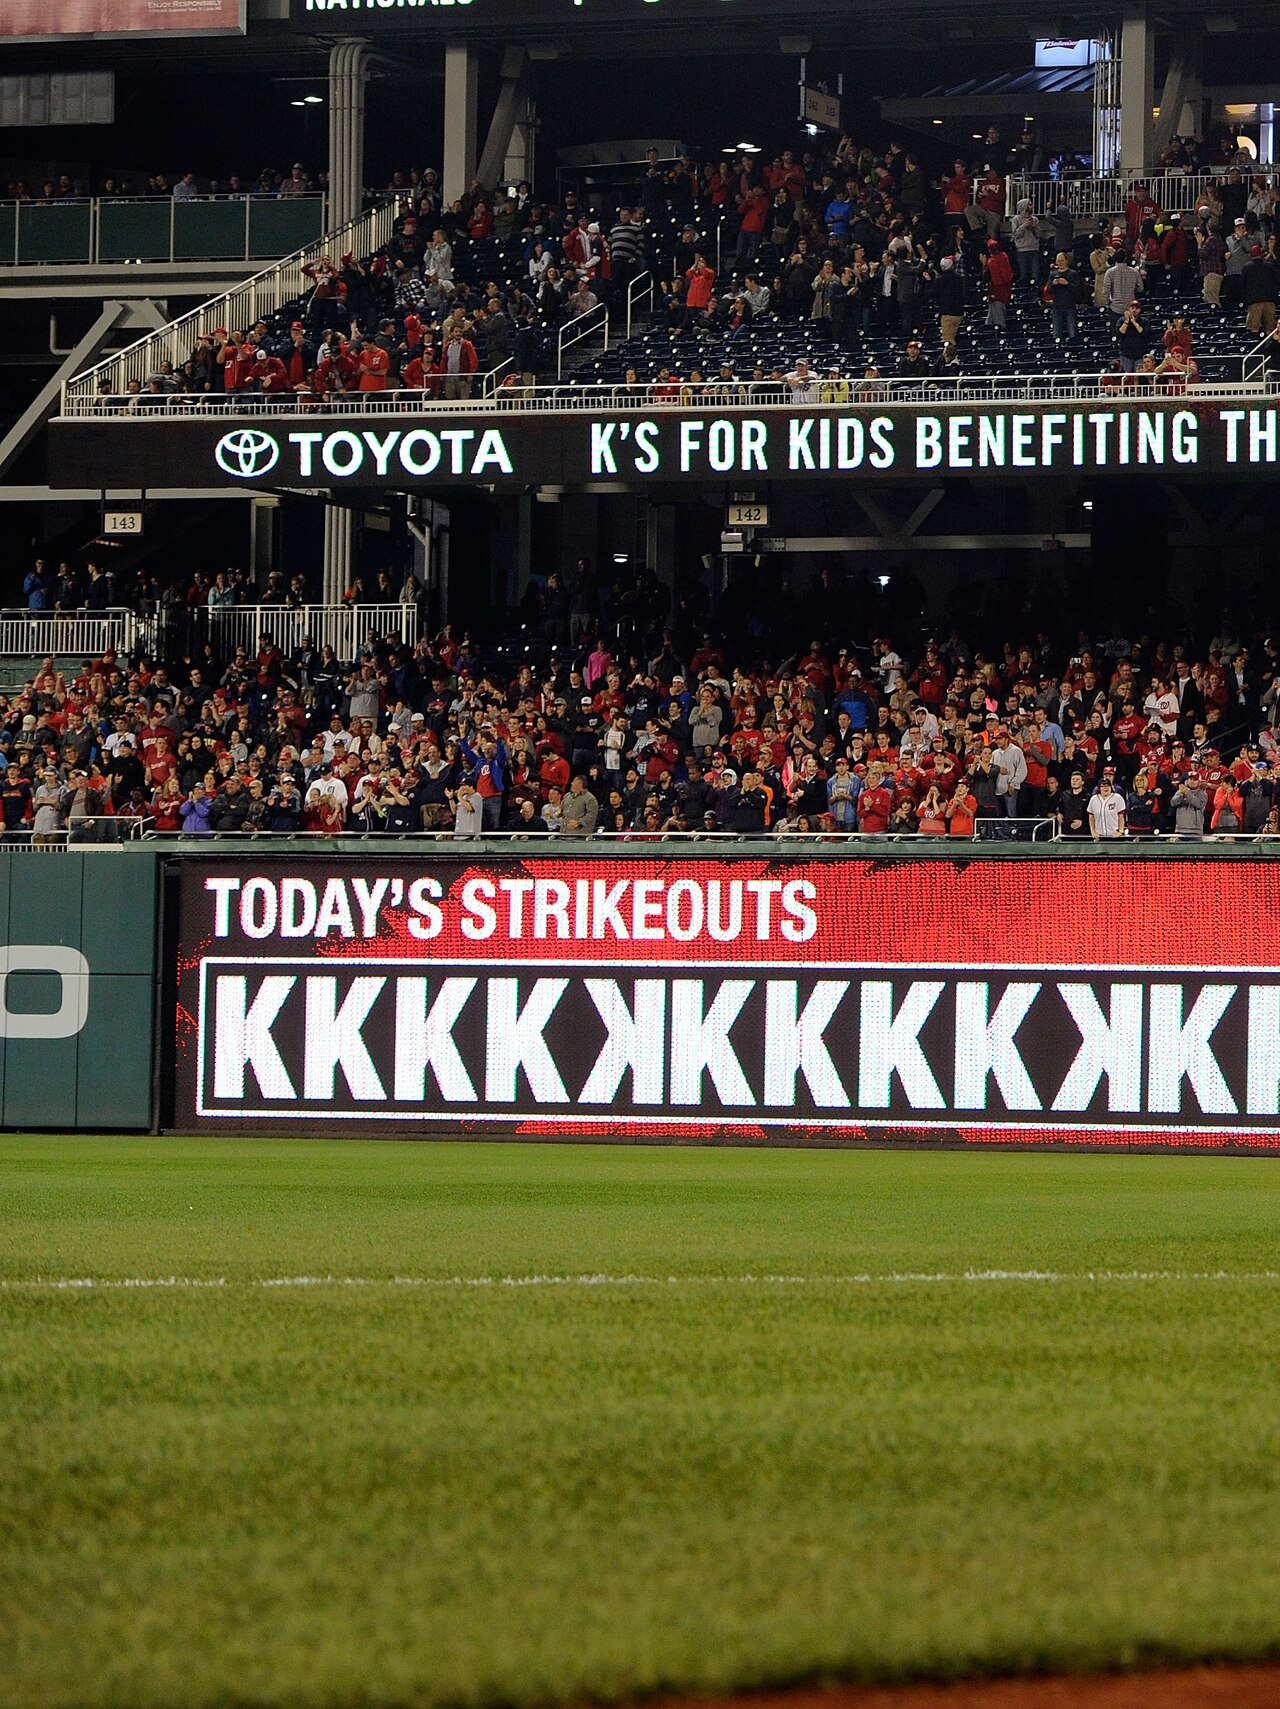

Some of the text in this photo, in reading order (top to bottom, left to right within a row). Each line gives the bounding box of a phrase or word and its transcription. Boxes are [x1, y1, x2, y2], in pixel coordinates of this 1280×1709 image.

[288, 430, 513, 477] TOYOTA
[592, 422, 659, 474] K'S
[681, 420, 768, 472] FOR
[789, 417, 895, 470] KIDS
[917, 411, 1198, 468] BENEFITING
[111, 516, 136, 530] 143
[736, 508, 762, 521] 142
[206, 876, 818, 943] TODAY'S STRIKEOUTS
